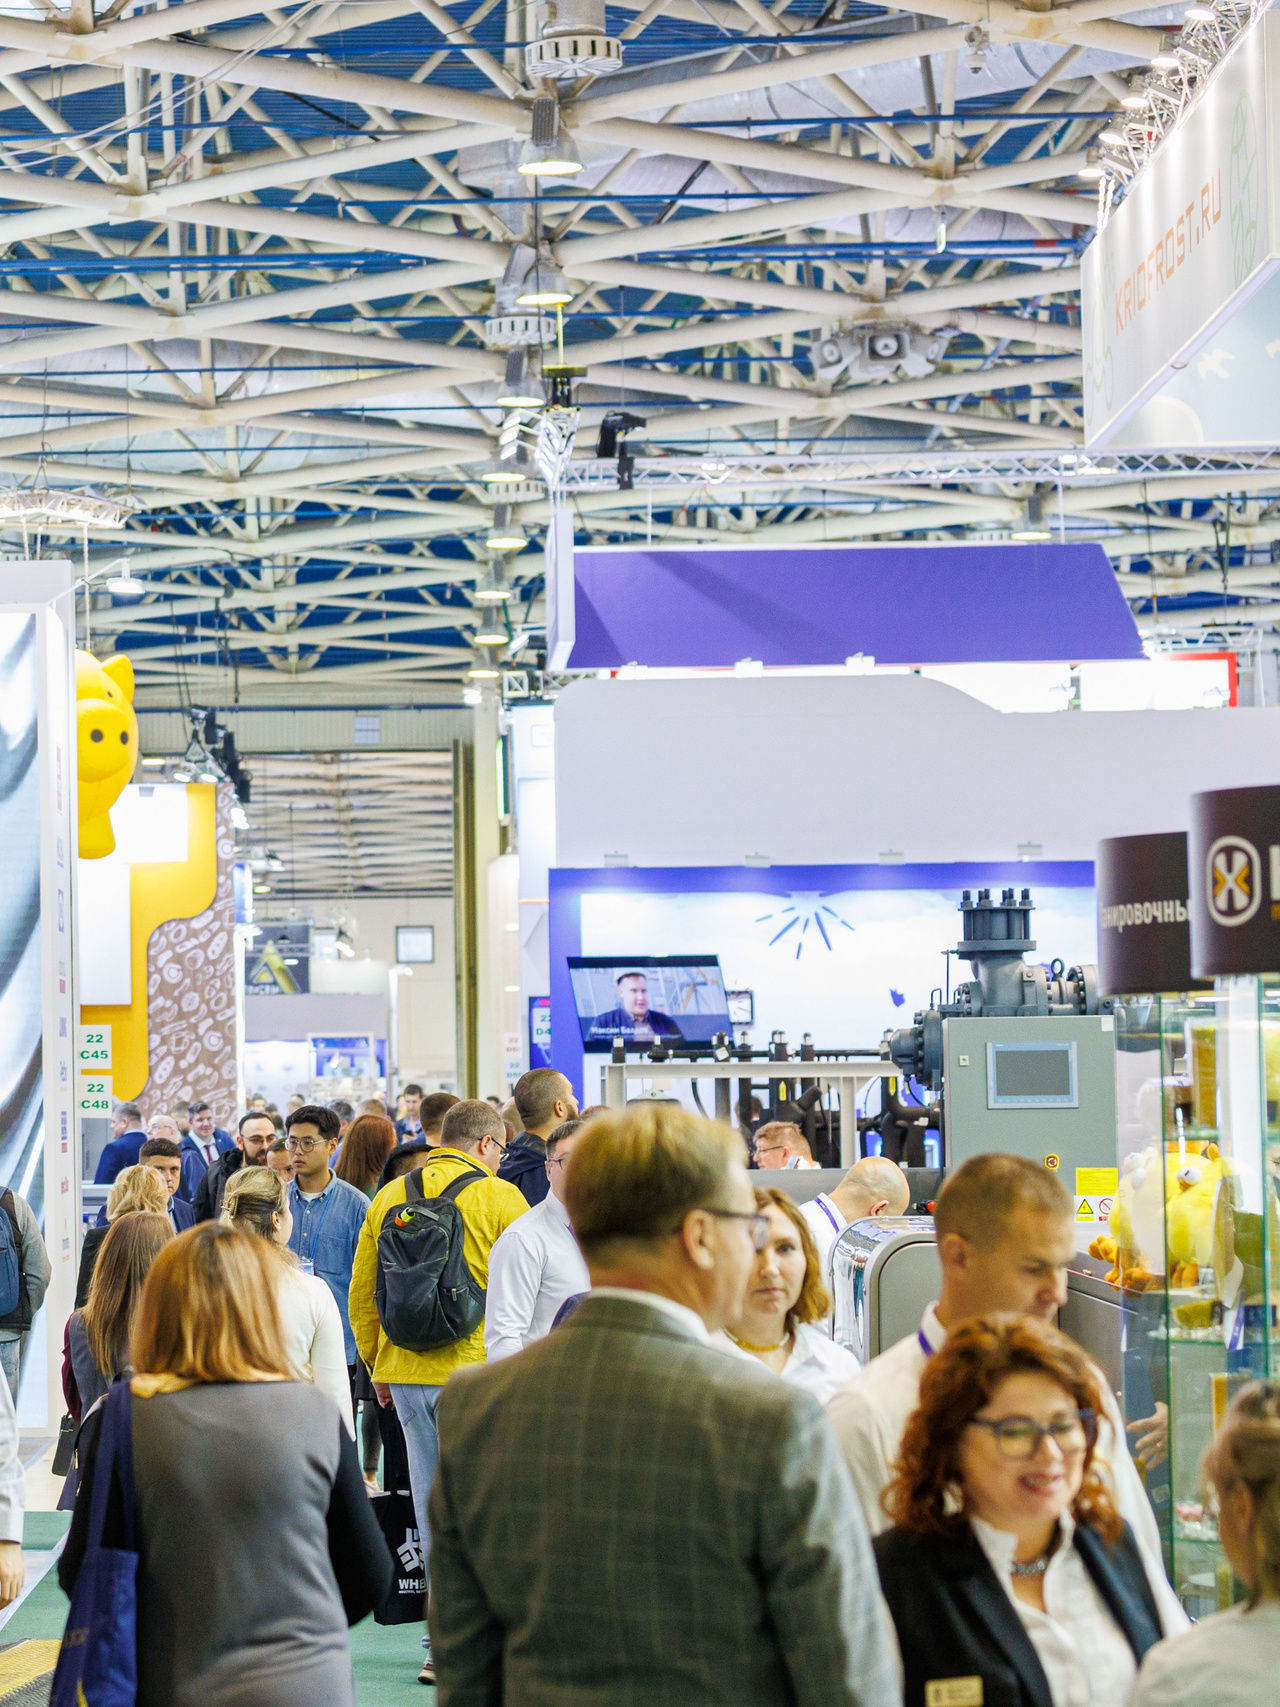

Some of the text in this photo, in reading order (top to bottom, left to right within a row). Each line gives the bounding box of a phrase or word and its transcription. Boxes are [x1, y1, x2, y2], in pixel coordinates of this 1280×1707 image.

[1115, 167, 1222, 337] KRIOFROST.RU
[86, 1034, 104, 1044] 22
[80, 1050, 109, 1060] C45
[87, 1083, 105, 1093] 22
[81, 1099, 109, 1110] C48
